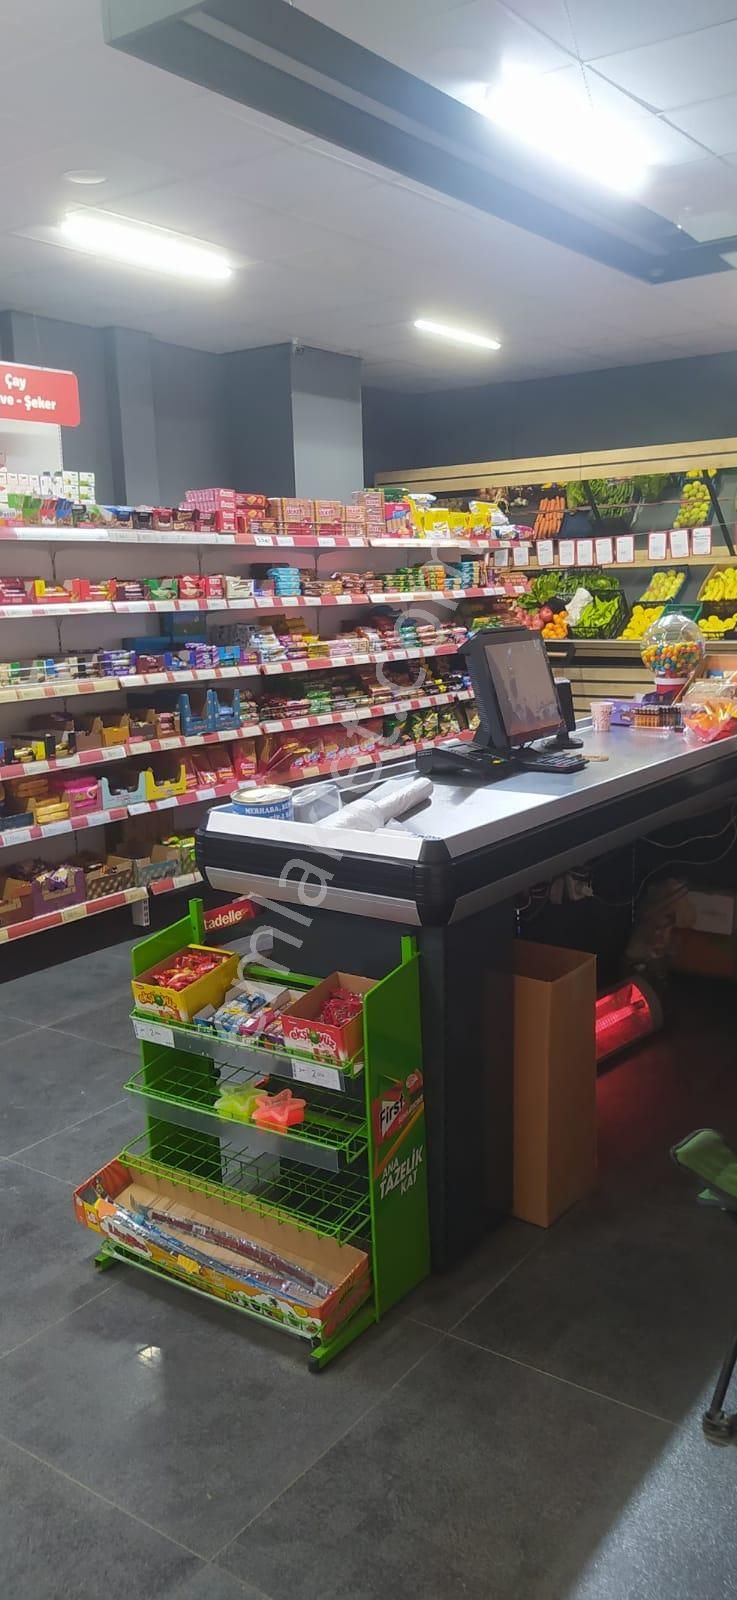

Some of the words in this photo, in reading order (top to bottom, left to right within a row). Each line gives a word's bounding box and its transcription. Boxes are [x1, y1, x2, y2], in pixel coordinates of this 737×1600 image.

[4, 372, 27, 391] Çay
[0, 394, 15, 406] ve
[23, 395, 57, 411] Şeker
[380, 1093, 405, 1126] First
[380, 1145, 424, 1200] TAZELİK
[400, 1169, 418, 1196] KAT
